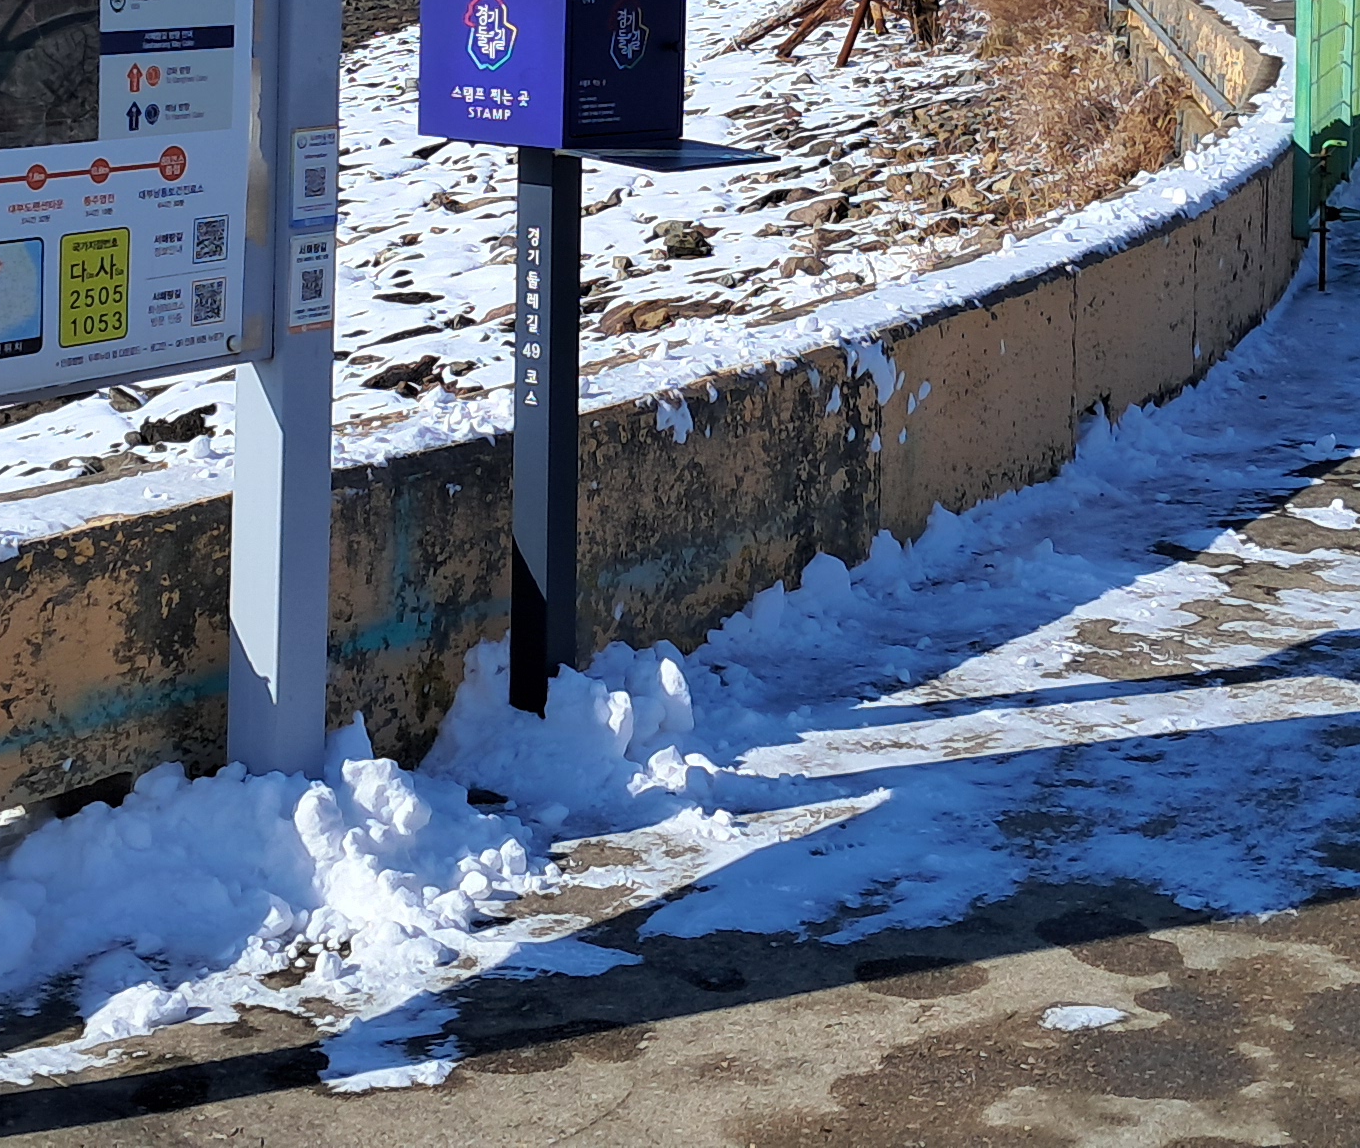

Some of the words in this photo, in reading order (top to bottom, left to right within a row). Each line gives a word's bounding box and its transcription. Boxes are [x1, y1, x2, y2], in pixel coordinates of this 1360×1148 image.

[451, 86, 486, 103] 스탬프
[490, 87, 514, 105] 찍는
[517, 90, 530, 107] 곳
[468, 107, 512, 121] STAMP
[70, 284, 123, 309] 2505
[70, 311, 123, 337] 1053
